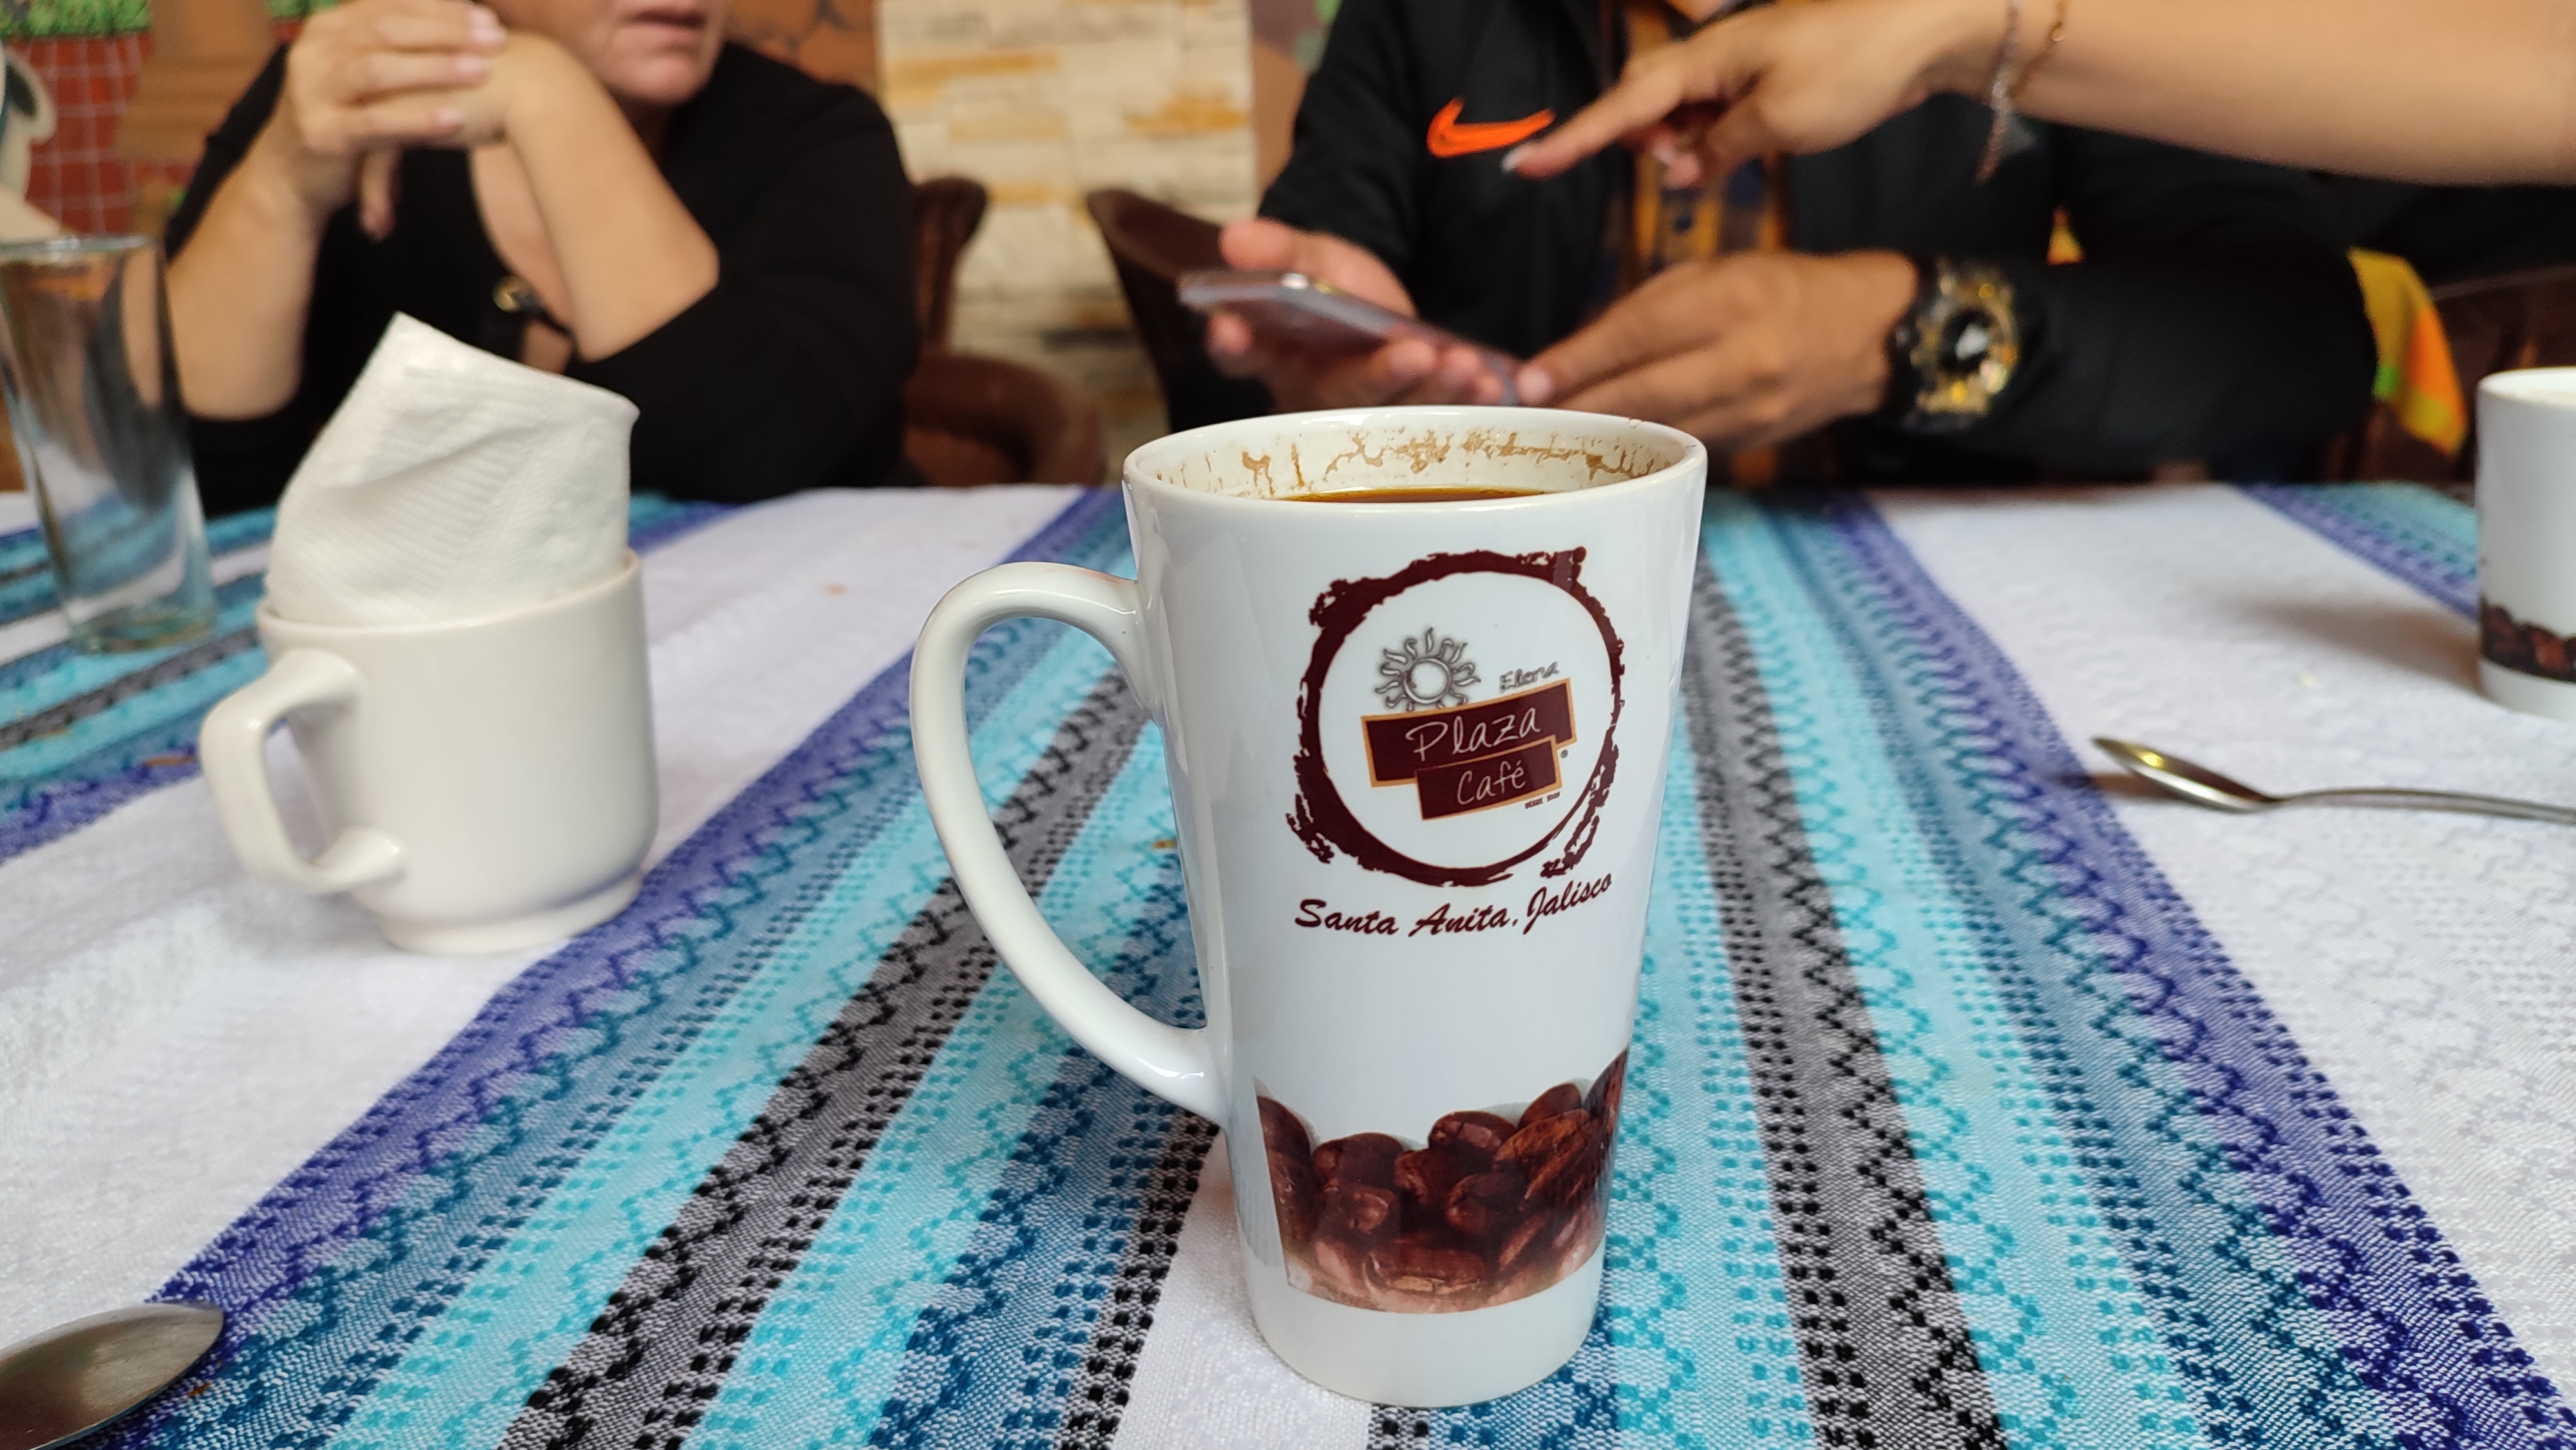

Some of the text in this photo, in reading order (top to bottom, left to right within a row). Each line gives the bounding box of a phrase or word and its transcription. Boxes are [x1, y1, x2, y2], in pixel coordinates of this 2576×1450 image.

[1405, 707, 1541, 762] Plaza
[1456, 759, 1526, 805] Café
[1294, 872, 1613, 937] Santa Anita, Jalisco
